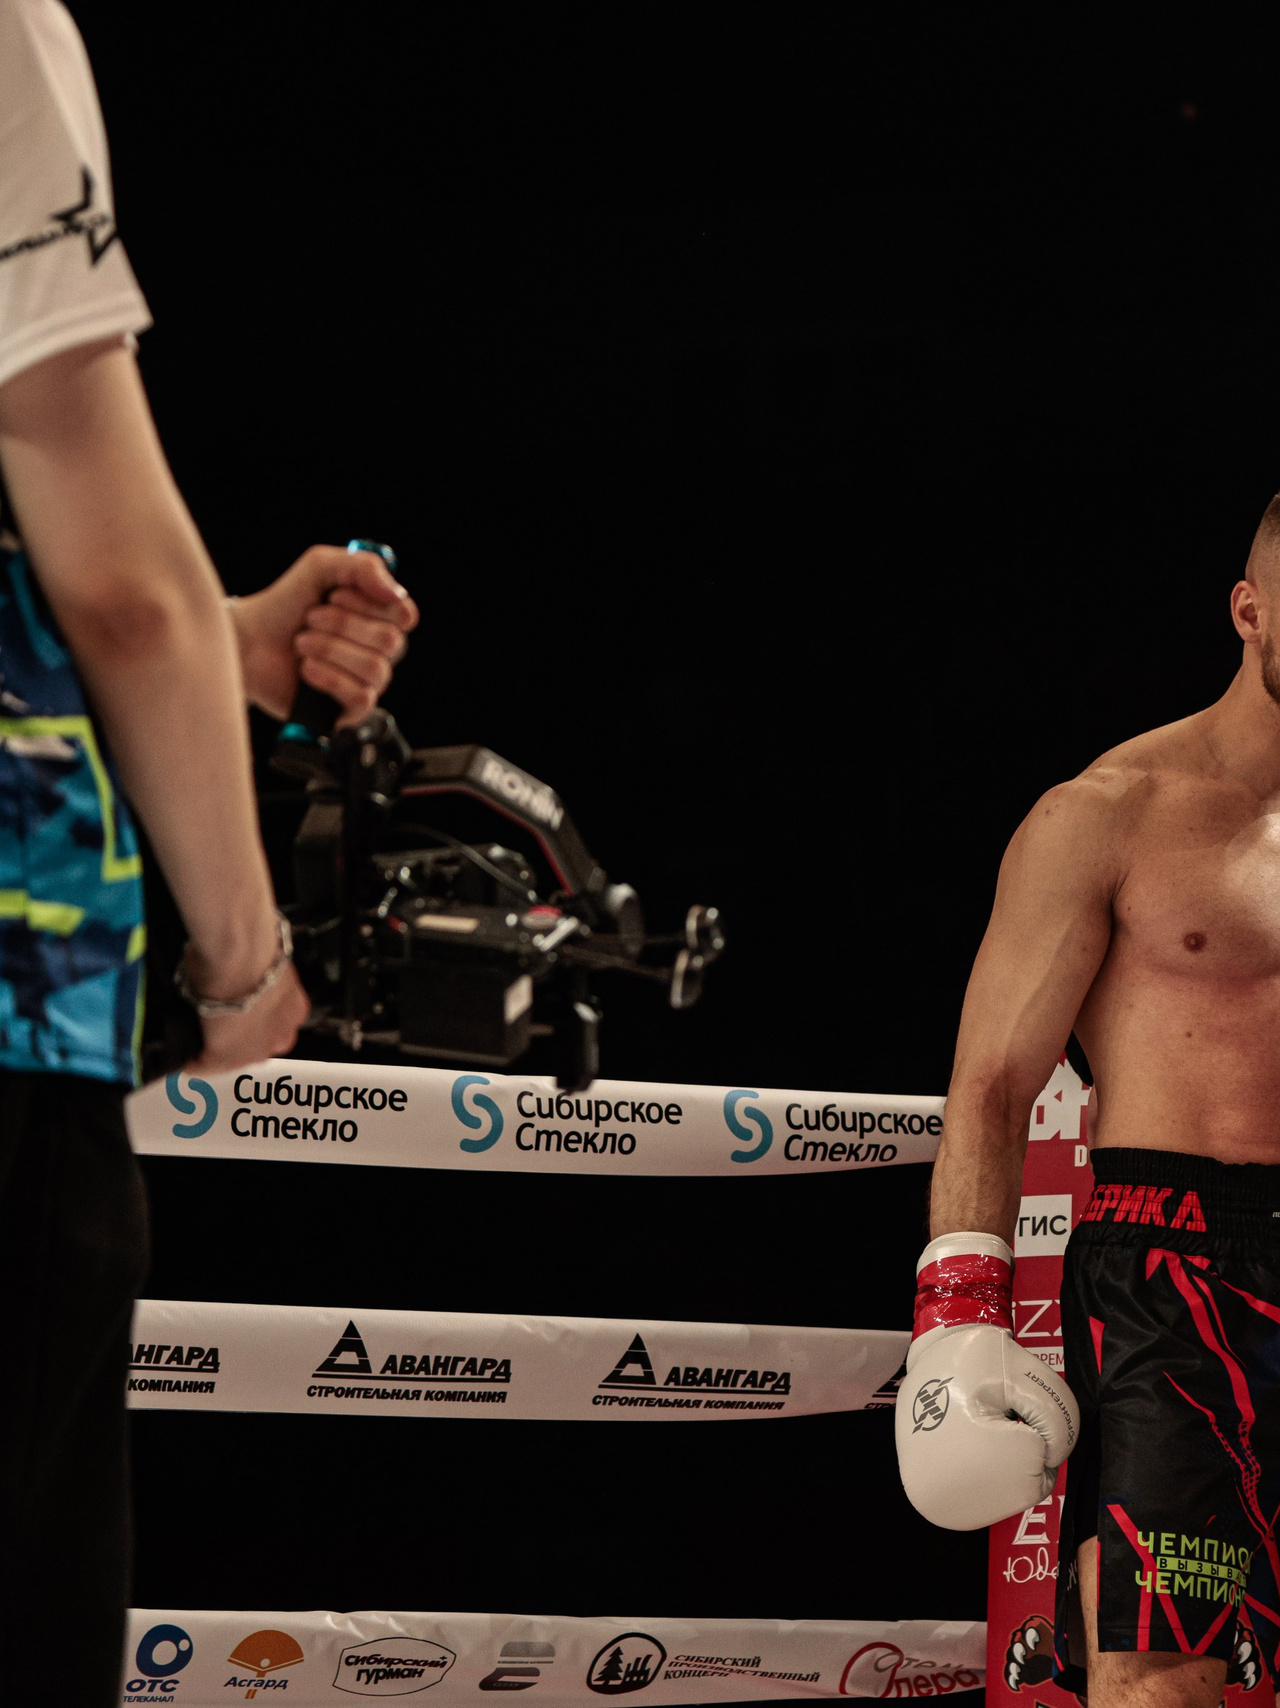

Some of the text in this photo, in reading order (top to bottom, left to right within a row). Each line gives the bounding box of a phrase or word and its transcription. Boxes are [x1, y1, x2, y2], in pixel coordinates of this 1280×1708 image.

[233, 1074, 409, 1113] Сибирское
[516, 1090, 683, 1127] Сибирское
[785, 1103, 943, 1138] Сибирское
[230, 1108, 359, 1143] Стекло
[515, 1122, 637, 1155] Стекло
[784, 1134, 898, 1162] Стекло
[1080, 1184, 1207, 1232] БРИКА
[380, 1355, 512, 1381] АВАНГАРД
[663, 1366, 792, 1394] АВАНГАРД
[128, 1379, 215, 1393] КОМПАНИЯ
[307, 1385, 507, 1403] СТРОИТЕЛЬНАЯ КОМПАНИЯ
[592, 1395, 785, 1411] СТРОИТЕЛЬНАЯ КОМПАНИЯ
[674, 1654, 762, 1668] СИБИРСКИЙ
[224, 1676, 289, 1690] Асгард
[356, 1667, 426, 1685] гурман
[663, 1669, 730, 1681] КОНЦЕРН
